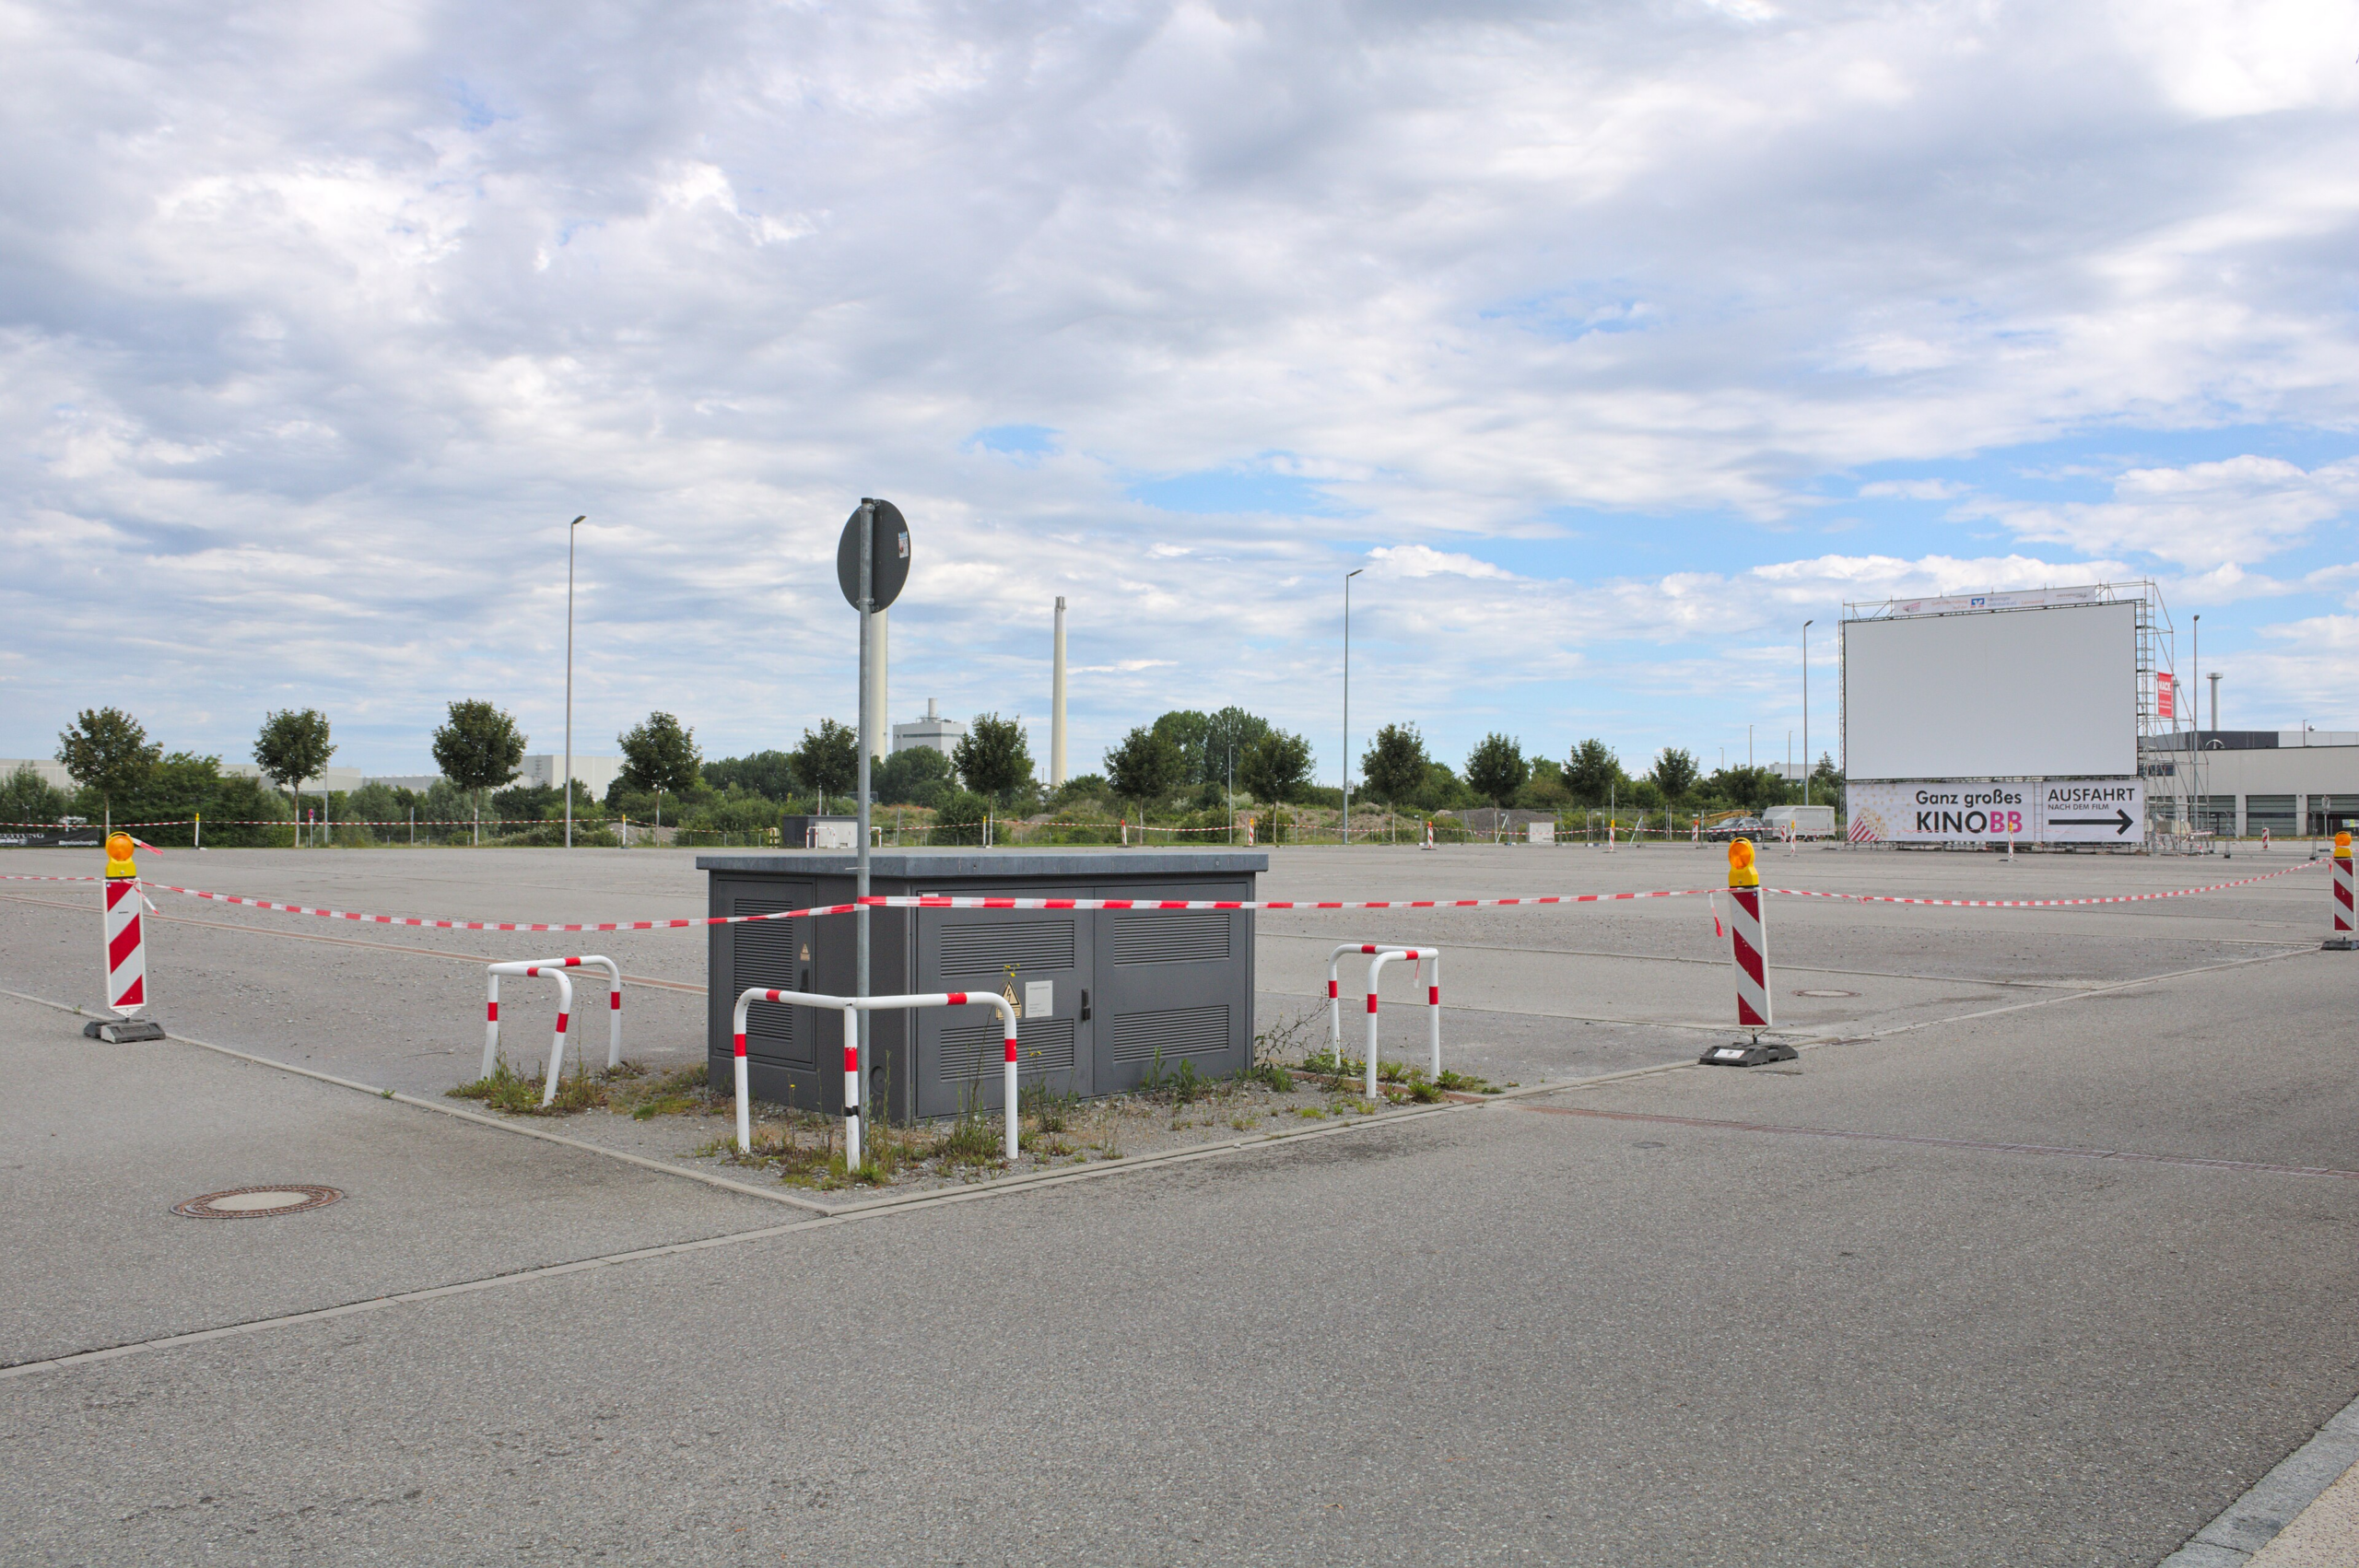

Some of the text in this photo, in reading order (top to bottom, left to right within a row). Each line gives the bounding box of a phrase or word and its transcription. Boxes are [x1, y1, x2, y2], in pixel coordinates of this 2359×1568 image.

[1916, 789, 2022, 808] Ganz großes
[2048, 788, 2135, 802] AUSFAHRT
[1917, 811, 2023, 834] KINOBB
